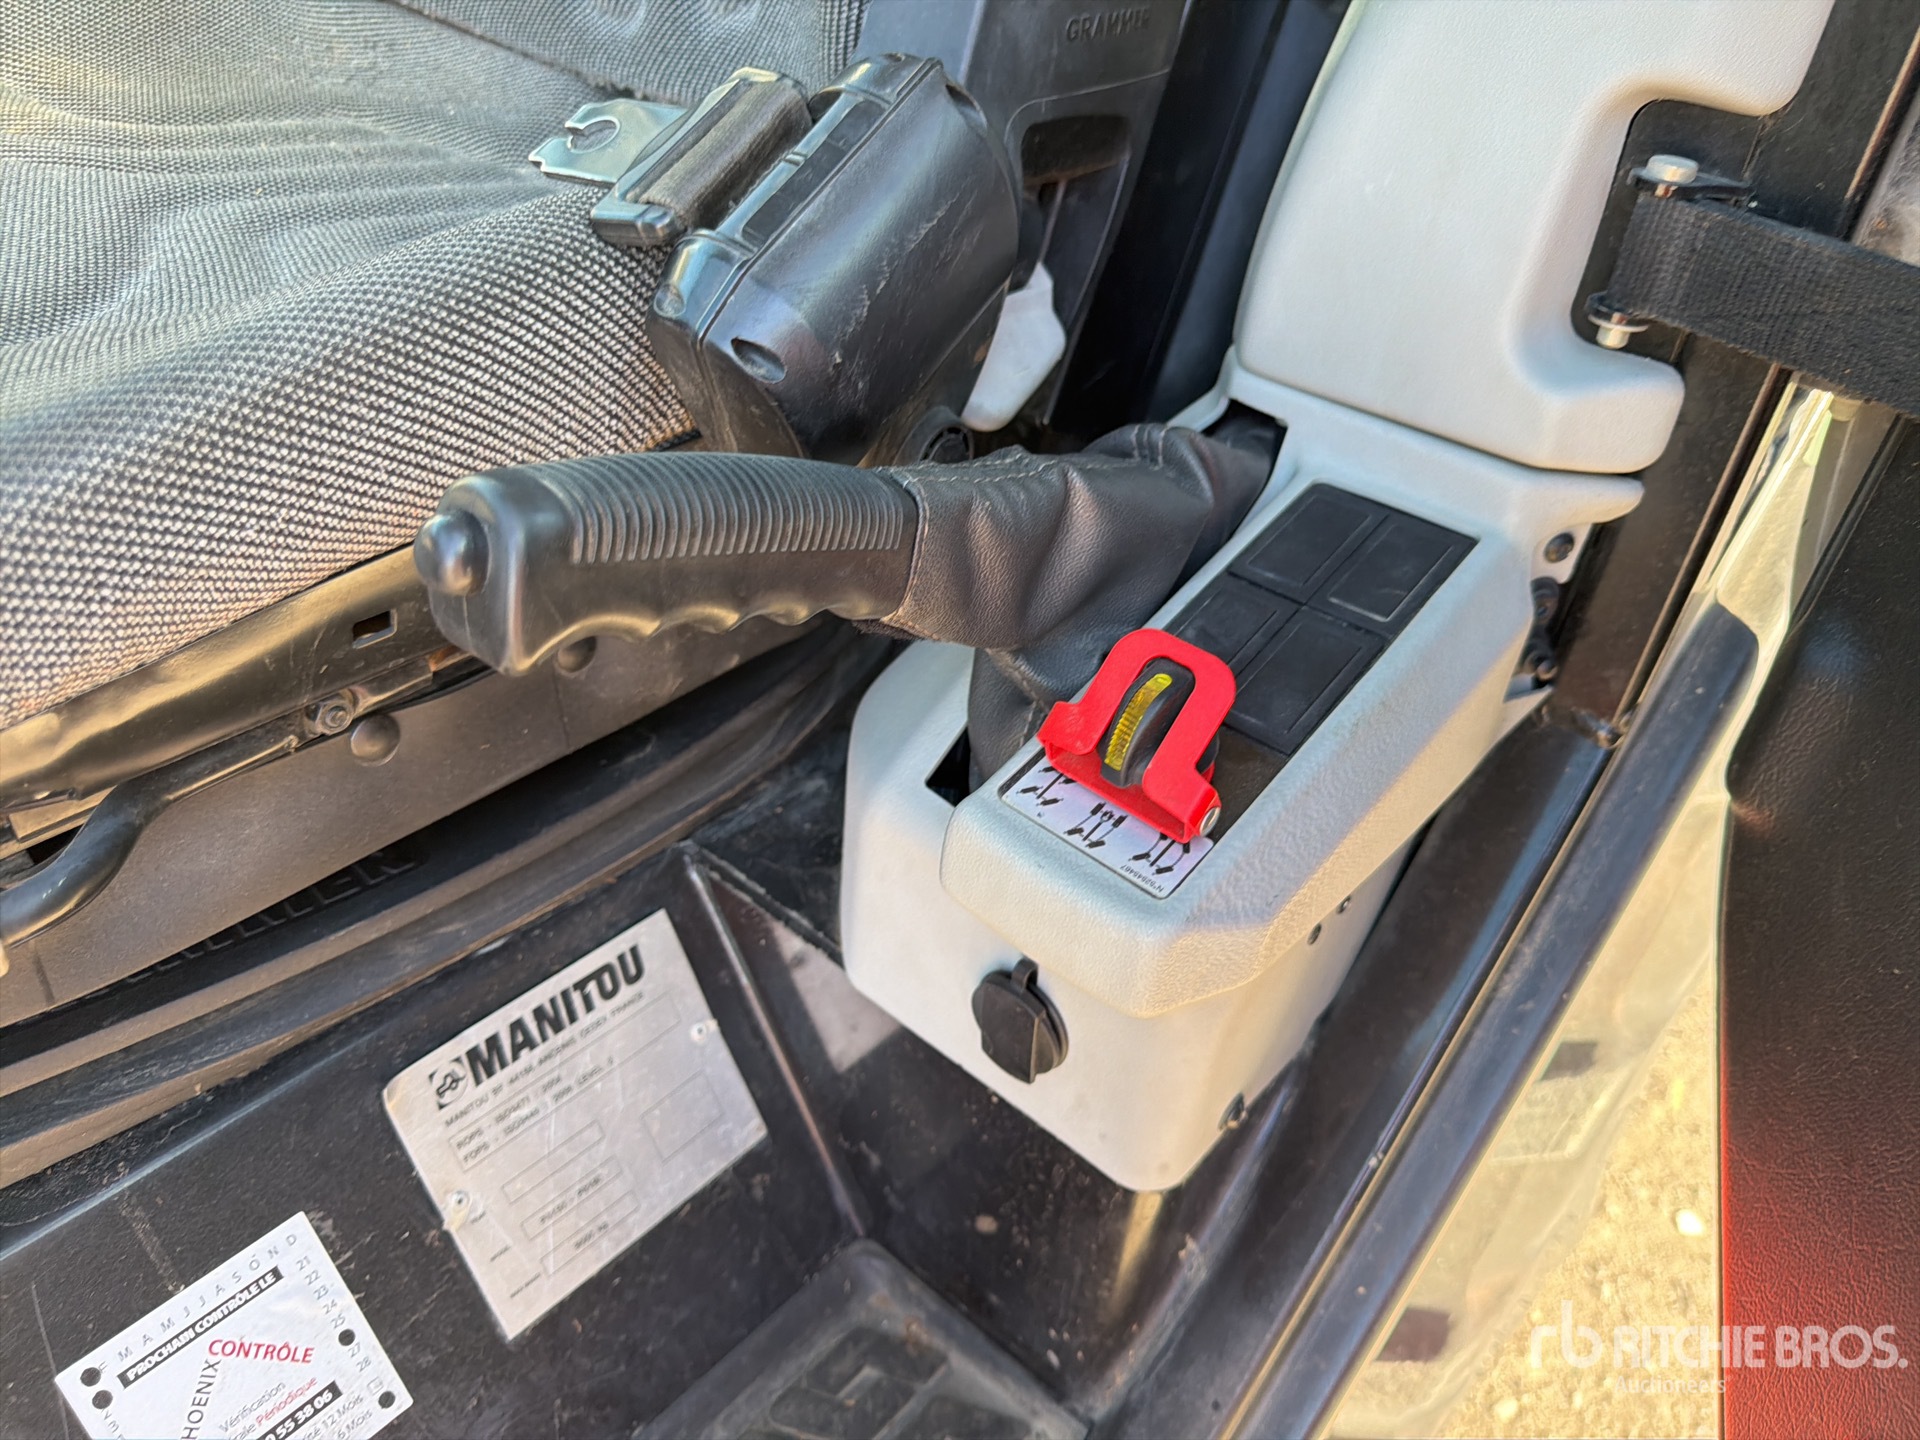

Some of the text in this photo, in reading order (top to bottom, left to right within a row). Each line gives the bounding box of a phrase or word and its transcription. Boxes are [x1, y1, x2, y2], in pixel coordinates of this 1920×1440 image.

[465, 944, 645, 1087] MANITOU
[445, 1092, 489, 1126] MANITOU
[295, 1255, 311, 1271] 21
[142, 1334, 154, 1347] A
[215, 1284, 226, 1296] A
[231, 1271, 242, 1284] S
[285, 1234, 297, 1246] D
[304, 1270, 320, 1286] 22
[313, 1285, 329, 1300] 23
[322, 1299, 338, 1315] 24
[126, 1327, 196, 1382] PROCHAIN
[259, 1272, 277, 1290] LE
[331, 1314, 346, 1329] 25
[208, 1339, 315, 1365] CONTRÔLE
[347, 1342, 362, 1358] 27
[356, 1356, 372, 1373] 28
[219, 1382, 287, 1433] Vérification
[255, 1377, 318, 1429] Périodique
[275, 1417, 297, 1438] 55
[294, 1403, 315, 1425] 38
[313, 1389, 333, 1411] 06
